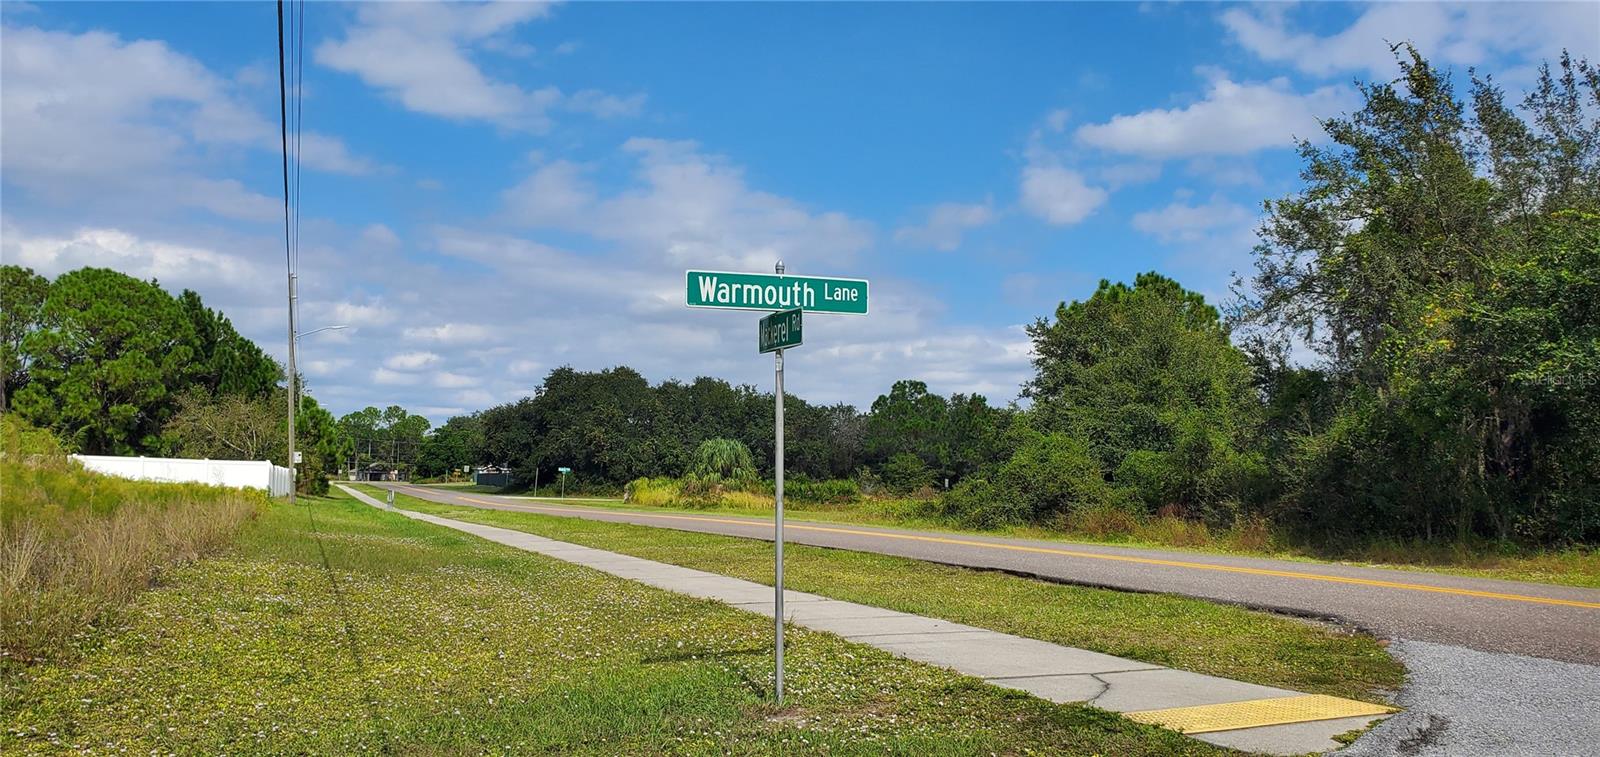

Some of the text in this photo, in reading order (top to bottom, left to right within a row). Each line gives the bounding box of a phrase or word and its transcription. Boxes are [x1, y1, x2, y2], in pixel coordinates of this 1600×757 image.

[698, 275, 858, 307] Warmouth Lane
[791, 313, 801, 331] Rd
